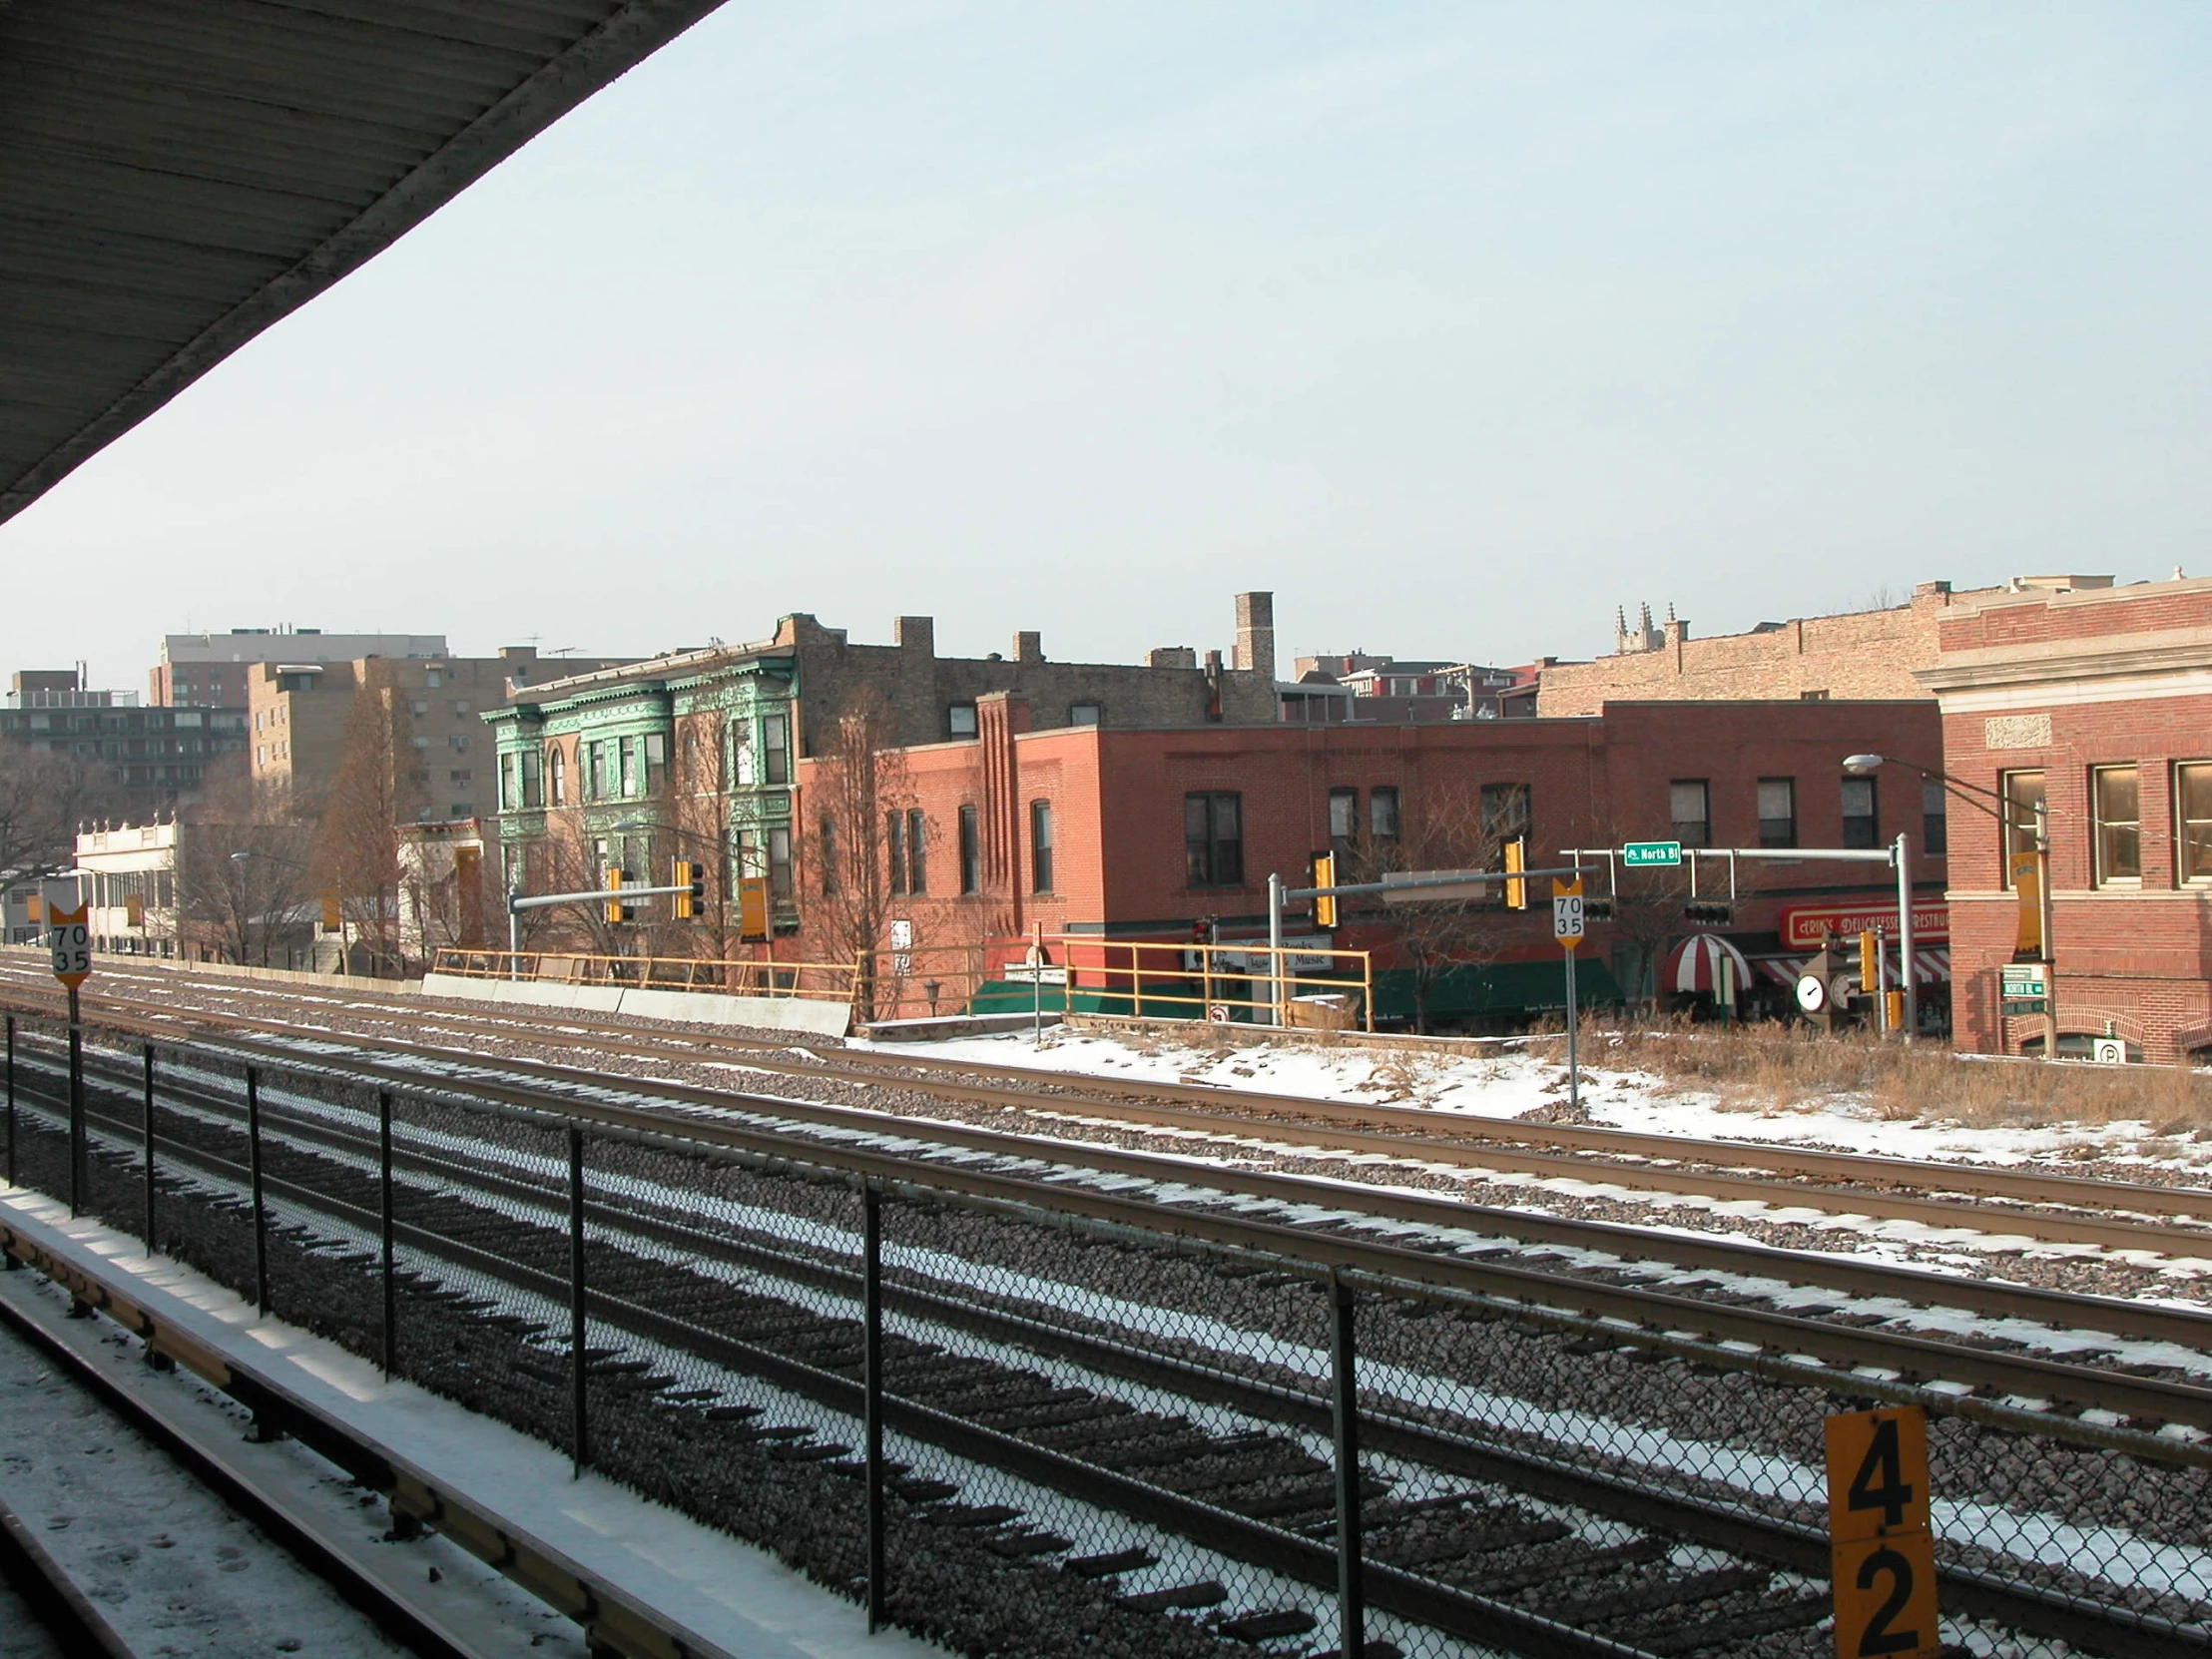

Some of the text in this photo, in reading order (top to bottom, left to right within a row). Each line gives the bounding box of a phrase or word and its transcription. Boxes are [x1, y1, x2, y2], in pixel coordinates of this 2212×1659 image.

[1640, 847, 1666, 860] North
[1556, 897, 1582, 915] 70
[1556, 917, 1582, 935] 35
[1841, 913, 1901, 934] DELICATESSE
[53, 925, 88, 947] 70
[55, 950, 89, 972] 35
[1295, 953, 1326, 966] Music
[1848, 1417, 1914, 1527] 4
[1856, 1548, 1920, 1658] 2
